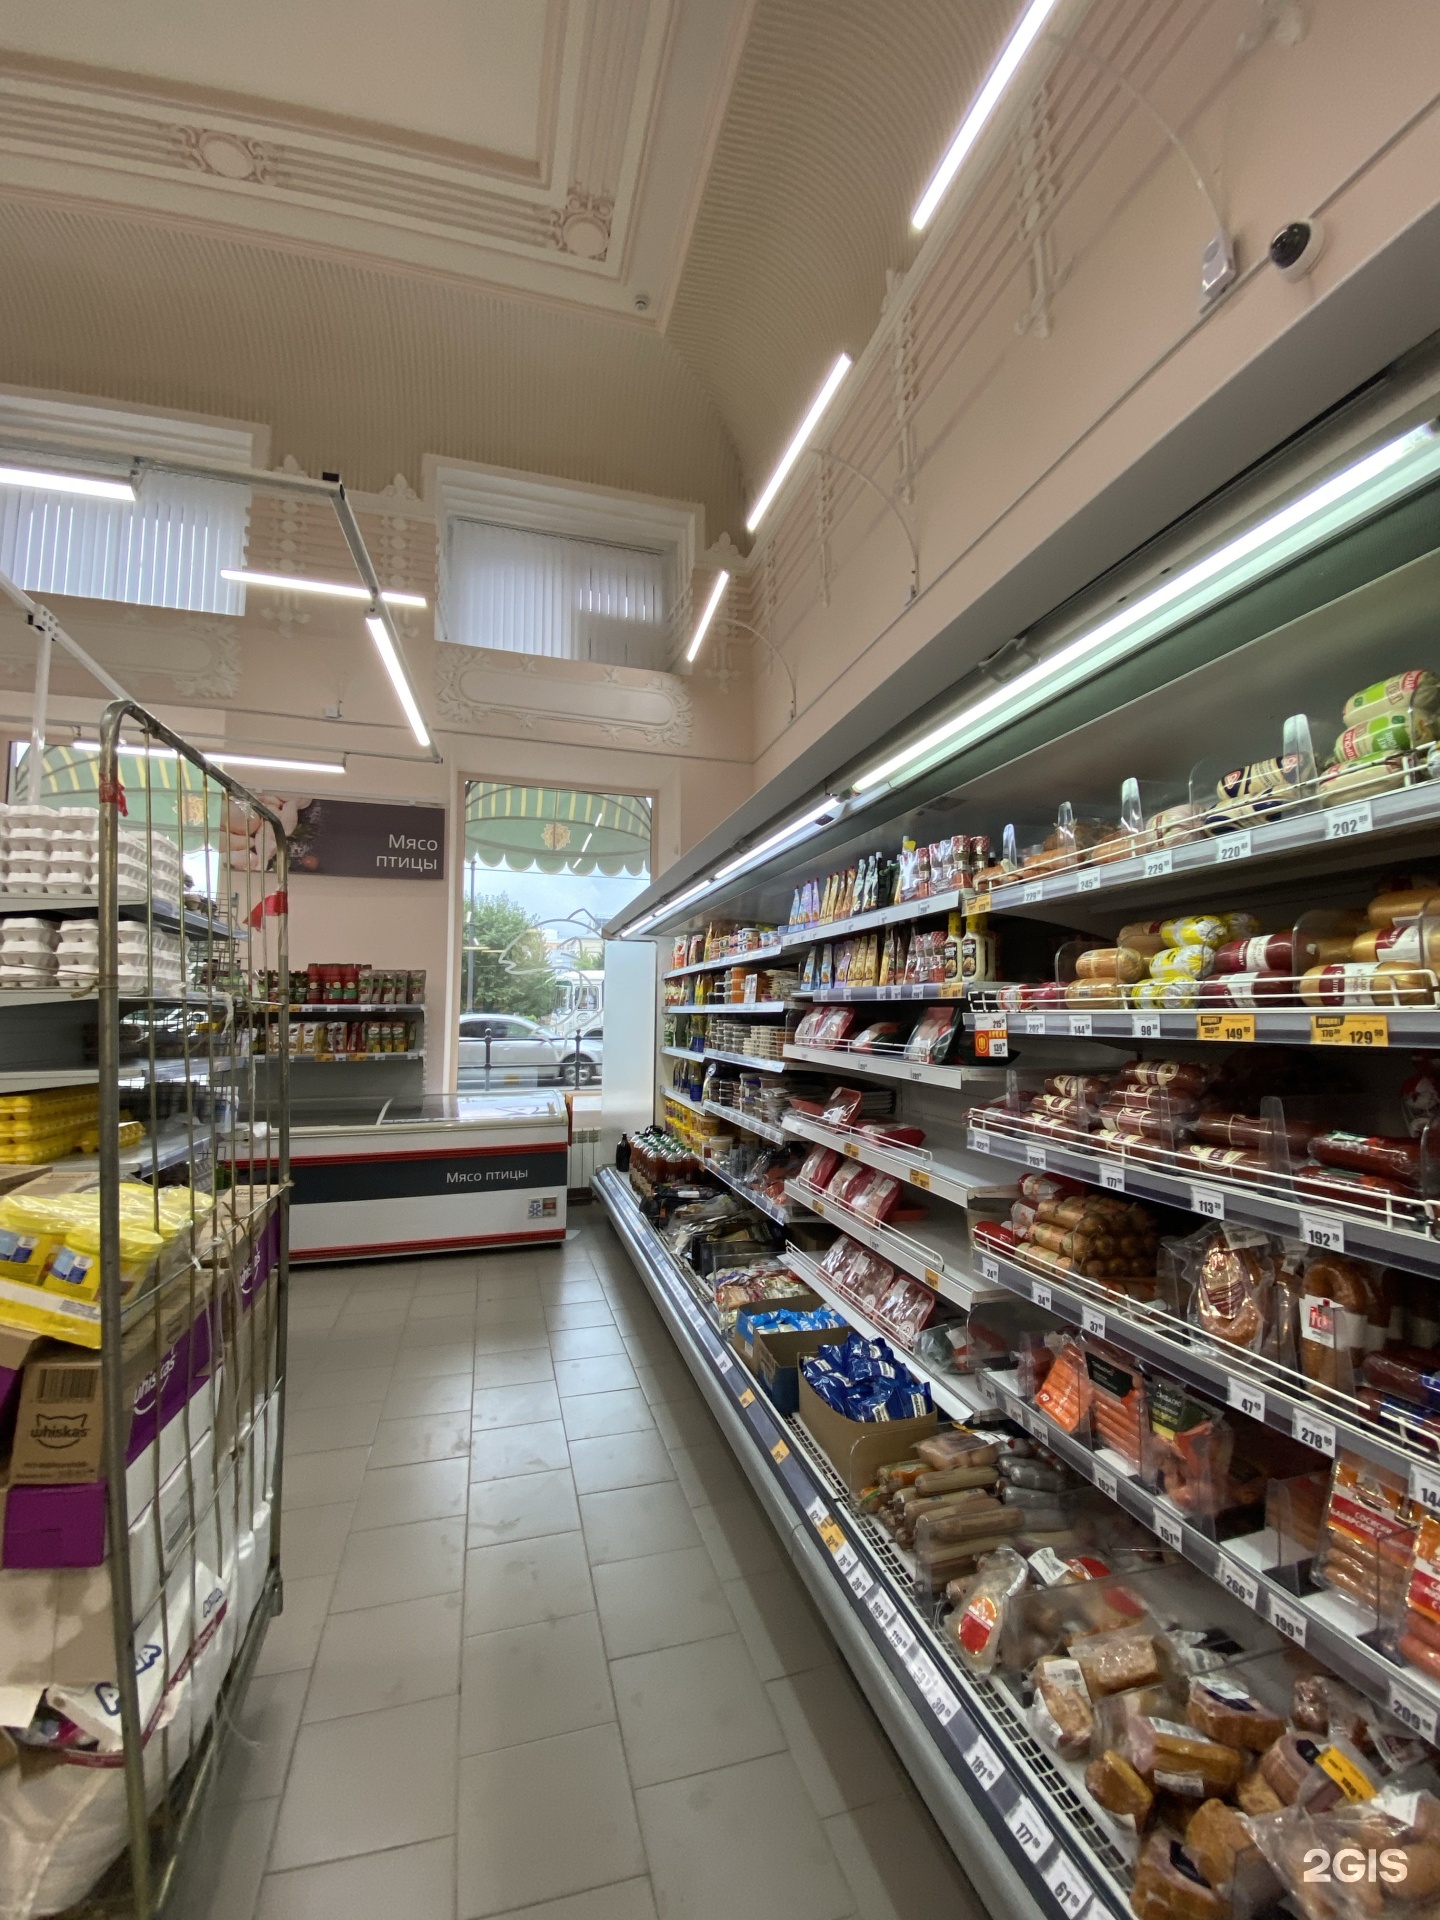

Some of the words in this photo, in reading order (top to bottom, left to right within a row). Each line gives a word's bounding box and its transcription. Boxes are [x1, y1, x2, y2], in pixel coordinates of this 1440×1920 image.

[1333, 819, 1357, 836] 202
[388, 833, 438, 851] Мясо
[1221, 846, 1240, 860] 220
[376, 855, 437, 873] птицы
[1147, 863, 1163, 876] 229
[1080, 880, 1093, 890] 245
[1073, 1025, 1085, 1035] 144
[1141, 1025, 1152, 1036] 98
[1225, 1028, 1242, 1039] 149
[1349, 1030, 1373, 1044] 129
[446, 1172, 482, 1184] Мясо
[485, 1169, 528, 1181] птицы
[1106, 1176, 1117, 1188] 177
[1199, 1200, 1214, 1214] 113
[1309, 1229, 1330, 1247] 192
[1089, 1320, 1098, 1333] 37
[1241, 1398, 1253, 1414] 47
[30, 1423, 91, 1438] whiskas
[1301, 1427, 1323, 1449] 278
[838, 1554, 848, 1567] 75
[852, 1577, 862, 1591] 39
[1226, 1575, 1245, 1599] 266
[1275, 1613, 1294, 1638] 199
[932, 1697, 945, 1715] 30
[971, 1756, 988, 1778] 181
[1015, 1822, 1034, 1845] 177
[1055, 1881, 1072, 1904] 61
